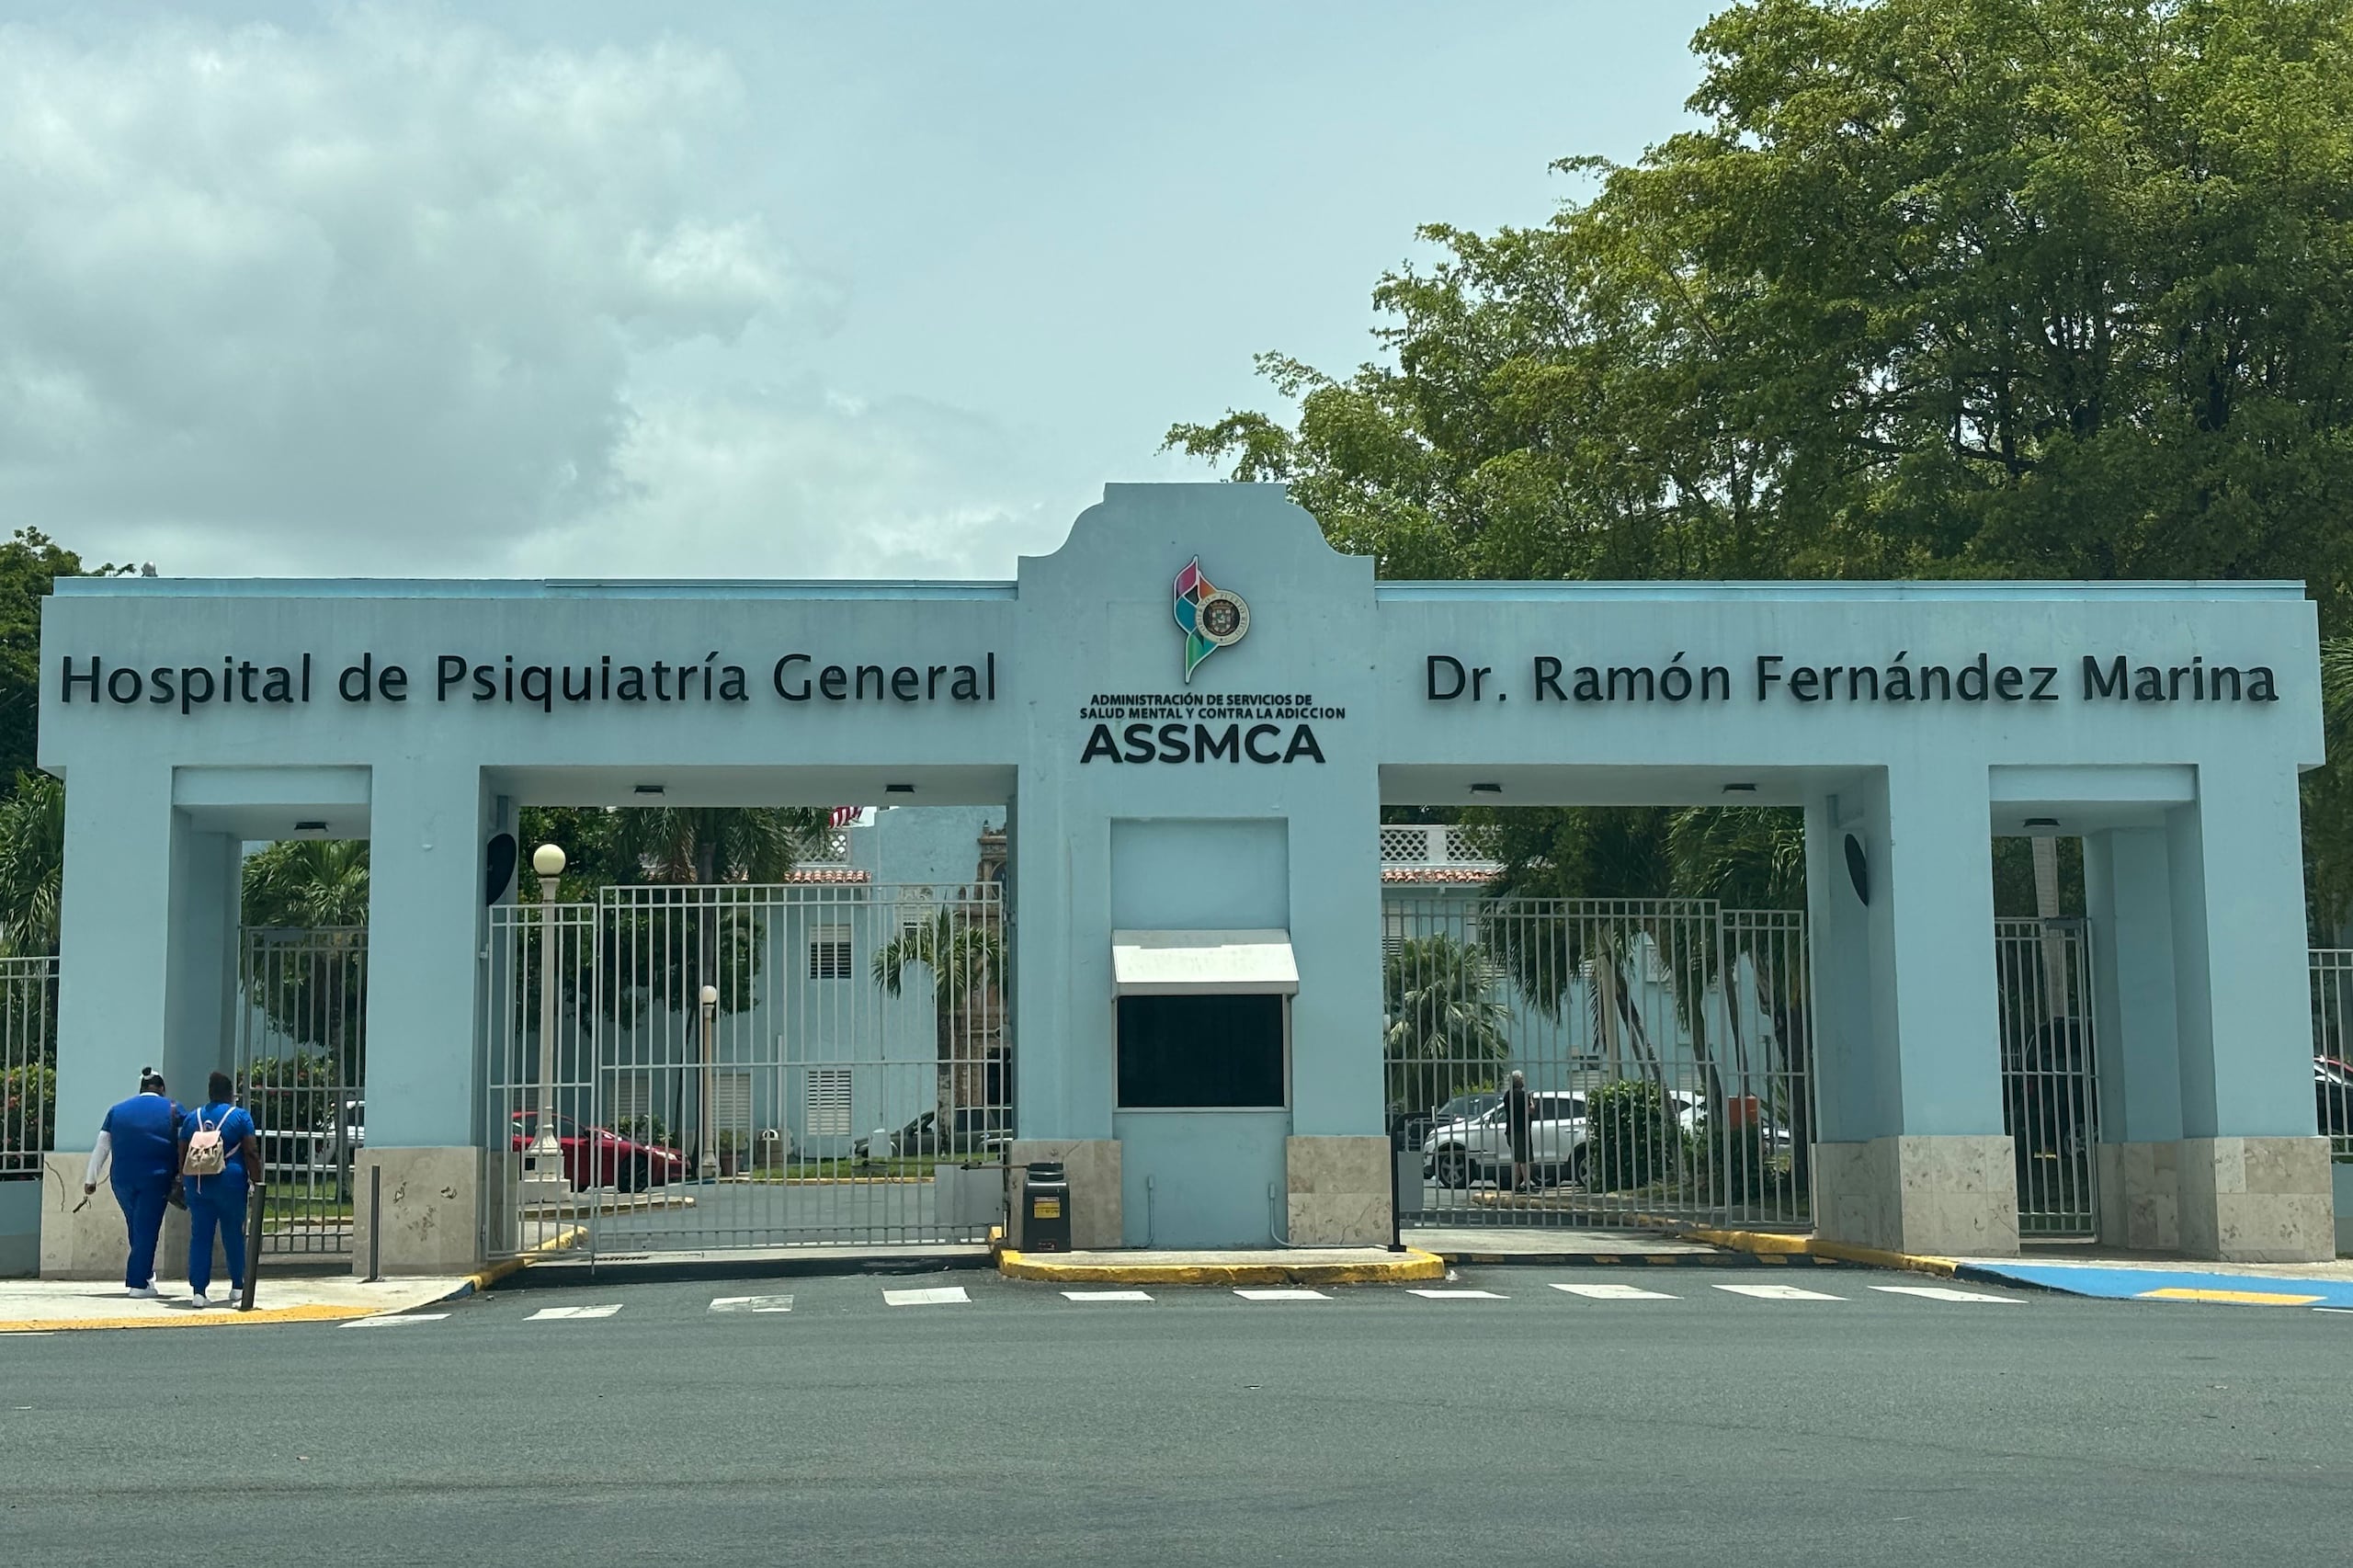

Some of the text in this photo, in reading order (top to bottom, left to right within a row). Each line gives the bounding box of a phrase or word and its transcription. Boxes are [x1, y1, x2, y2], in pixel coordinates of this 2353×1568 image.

[62, 651, 995, 715] Hospital de Psiquiatría General
[1427, 651, 2279, 703] Dr. Ramón Fernández Marina
[1080, 707, 1346, 720] SALUD MENTAL Y CONTRA LA ADICCION
[1090, 692, 1313, 706] ADMINISTRACIÓN DE SERVICIOS DE
[1080, 723, 1325, 765] ASSMCA
